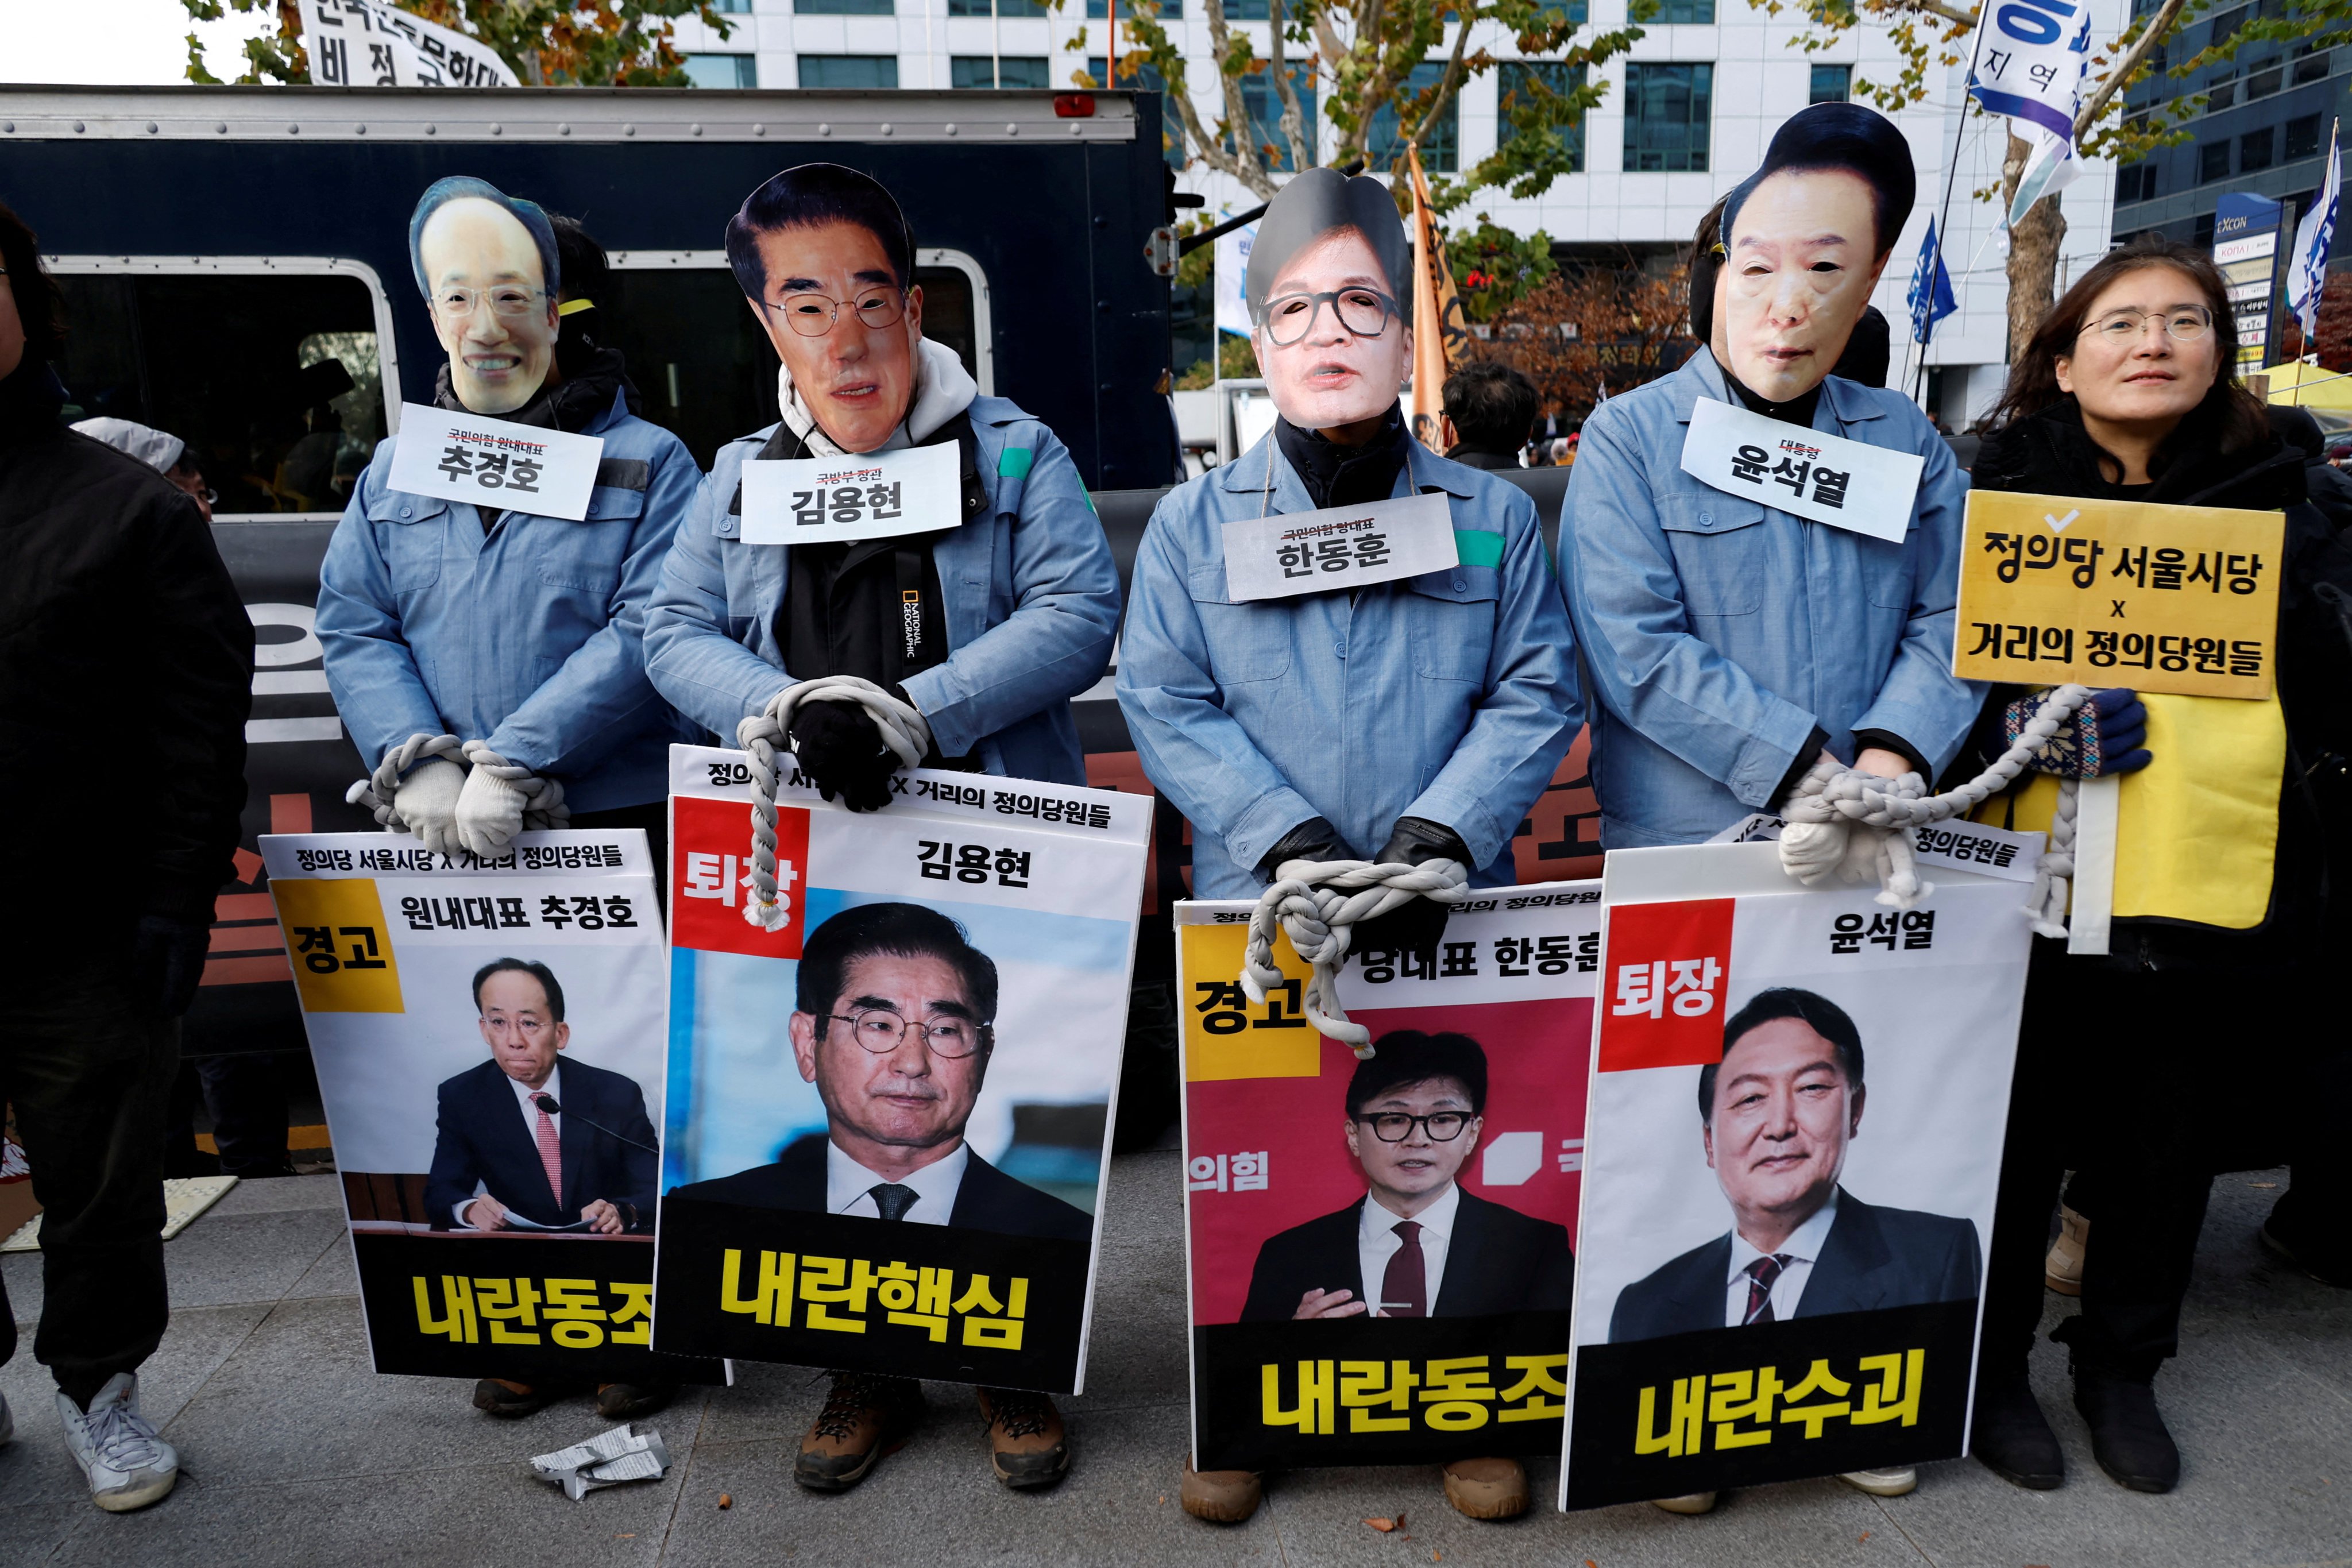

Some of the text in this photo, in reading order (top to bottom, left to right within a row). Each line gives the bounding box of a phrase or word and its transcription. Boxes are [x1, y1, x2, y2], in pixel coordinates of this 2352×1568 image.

[449, 428, 544, 455] 국민의힘 원내대표
[1780, 439, 1819, 460] 대통령
[438, 445, 544, 493] 추경호
[816, 469, 883, 485] 국방부 장관
[1731, 445, 1851, 509] 윤석열
[790, 481, 902, 526] 김용현
[1283, 519, 1375, 541] 국민의힘 당대표
[1276, 533, 1391, 578] 한동훈
[1984, 532, 2263, 595] 정의당 서울시당
[903, 603, 914, 658] GEOGRAPHIC
[911, 603, 921, 646] NATIONAL
[1968, 622, 2262, 677] 거리의 정의당원들
[916, 779, 985, 809] 거리의
[992, 791, 1111, 829] 정의당원들
[296, 849, 352, 871] 정의당
[360, 848, 434, 871] 서울시당
[522, 845, 623, 870] 정의당원들
[917, 840, 1031, 889] 김용현
[1916, 827, 2019, 868] 정의당원들
[401, 895, 638, 930] 원내대표 추경호
[1449, 899, 1498, 913] 리의
[293, 926, 387, 974] 경고
[1829, 910, 1935, 954] 윤석열
[1195, 978, 1307, 1035] 경고
[1612, 956, 1721, 1019] 퇴장
[1189, 1151, 1268, 1193] 의힘
[412, 1275, 652, 1349] 내란동조
[721, 1249, 1029, 1351] 내란핵심
[1262, 1354, 1567, 1435] 내란동조
[1635, 1348, 1925, 1458] 내란수괴
